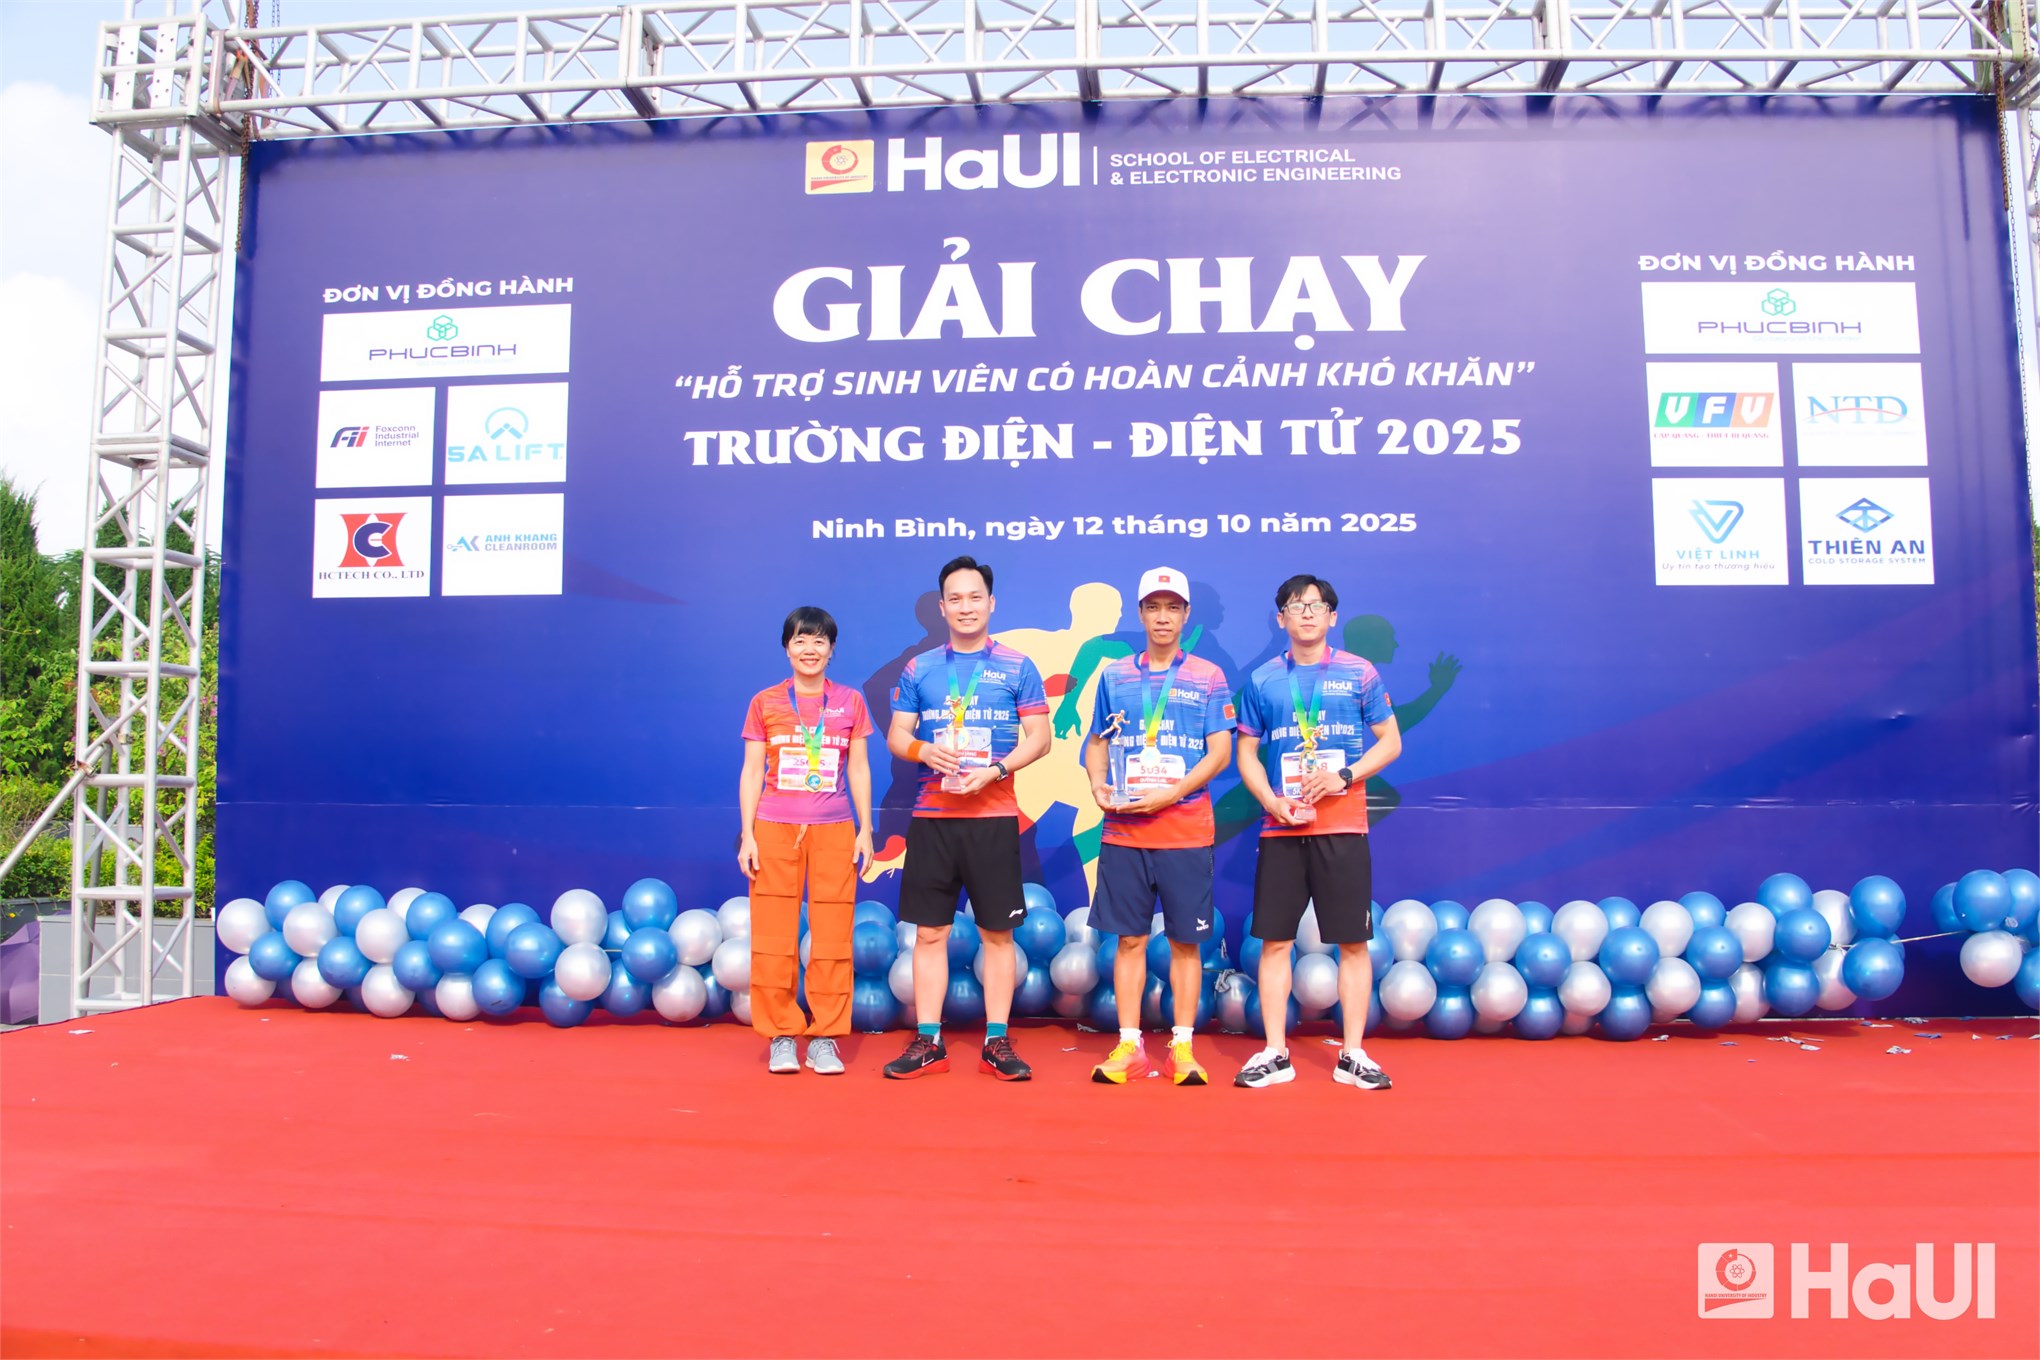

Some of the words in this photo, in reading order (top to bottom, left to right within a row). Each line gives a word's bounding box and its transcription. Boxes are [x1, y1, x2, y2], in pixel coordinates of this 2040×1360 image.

[888, 132, 1080, 192] HaUI
[1111, 152, 1194, 166] SCHOOL
[1200, 151, 1225, 164] OF
[1232, 149, 1355, 163] ELECTRICAL
[1111, 172, 1123, 185] &
[1131, 169, 1257, 184] ELECTRONIC
[1264, 167, 1401, 181] ENGINEERING
[1638, 253, 1701, 270] ĐƠN
[1709, 255, 1736, 275] VỊ
[1744, 250, 1827, 270] ĐỒNG
[1836, 252, 1914, 270] HÀNH
[323, 285, 378, 303] ĐƠN
[386, 285, 409, 303] VỊ
[416, 278, 491, 298] ĐỒNG
[500, 276, 573, 295] HÀNH
[773, 237, 1036, 342] GIẢI
[1081, 255, 1427, 350] CHẠY
[1698, 322, 1861, 333] PHUCBINH
[369, 344, 516, 360] PHUCBINH
[753, 369, 825, 401] TRỢ
[833, 370, 921, 395] SINH
[932, 363, 1018, 392] VIÊN
[1027, 361, 1074, 391] CÓ
[1084, 359, 1192, 390] HOÀN
[1203, 356, 1307, 387] CẢNH
[1317, 356, 1395, 386] KHÓ
[1807, 396, 1908, 424] NTD
[375, 432, 419, 440] Industrial
[684, 421, 924, 465] TRƯỜNG
[942, 417, 1073, 467] ĐIỆN
[1093, 441, 1111, 449] -
[1129, 413, 1262, 464] ĐIỆN
[1280, 407, 1363, 455] TỬ
[1378, 419, 1520, 455] 2025
[813, 518, 884, 538] Ninh
[896, 518, 975, 540] Bình,
[986, 516, 1064, 540] ngày
[1073, 517, 1103, 534] 12
[1112, 514, 1207, 537] tháng
[1218, 514, 1250, 532] 10
[1261, 513, 1331, 532] năm
[1341, 513, 1416, 531] 2025
[485, 534, 511, 542] ANH
[515, 533, 558, 542] KHANG
[1808, 537, 1882, 555] THIÊN
[1890, 540, 1925, 555] AN
[485, 542, 558, 551] CLEANROOM
[1677, 547, 1713, 562] VIỆT
[1720, 550, 1760, 560] LINH
[319, 571, 369, 580] HCTECH
[401, 570, 425, 579] LTD
[1177, 689, 1200, 700] HaUI
[1328, 681, 1353, 691] HaUI
